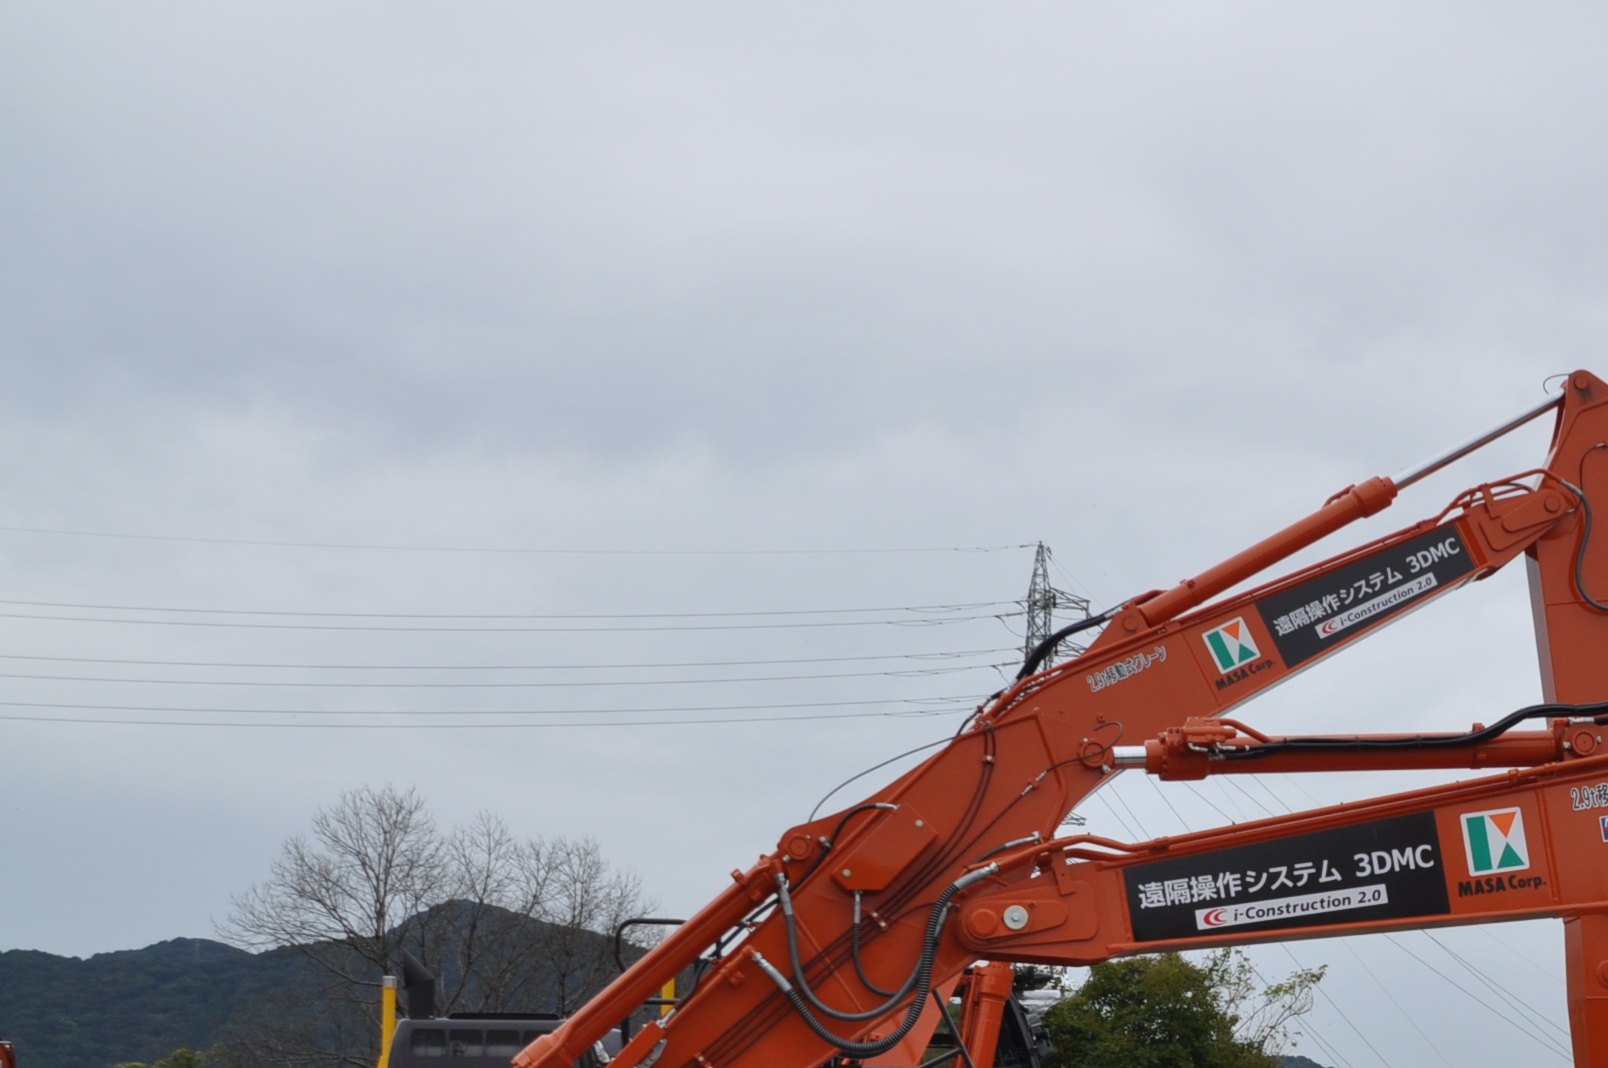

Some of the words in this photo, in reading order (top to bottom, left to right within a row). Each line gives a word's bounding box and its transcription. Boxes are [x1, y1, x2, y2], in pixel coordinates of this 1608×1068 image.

[1272, 566, 1403, 637] 遠隔操作システム
[1405, 537, 1460, 574] 3DMC
[1339, 582, 1415, 627] i-Construction
[1415, 577, 1433, 592] 2.0
[1214, 669, 1250, 692] MASA
[1248, 659, 1277, 675] Corp.
[1138, 859, 1343, 909] 遠隔操作システム
[1352, 844, 1435, 878] 3DMC
[1457, 876, 1507, 897] MASA
[1508, 873, 1547, 891] Corp.
[1233, 893, 1352, 922] i-Construction
[1356, 889, 1382, 904] 2.0
